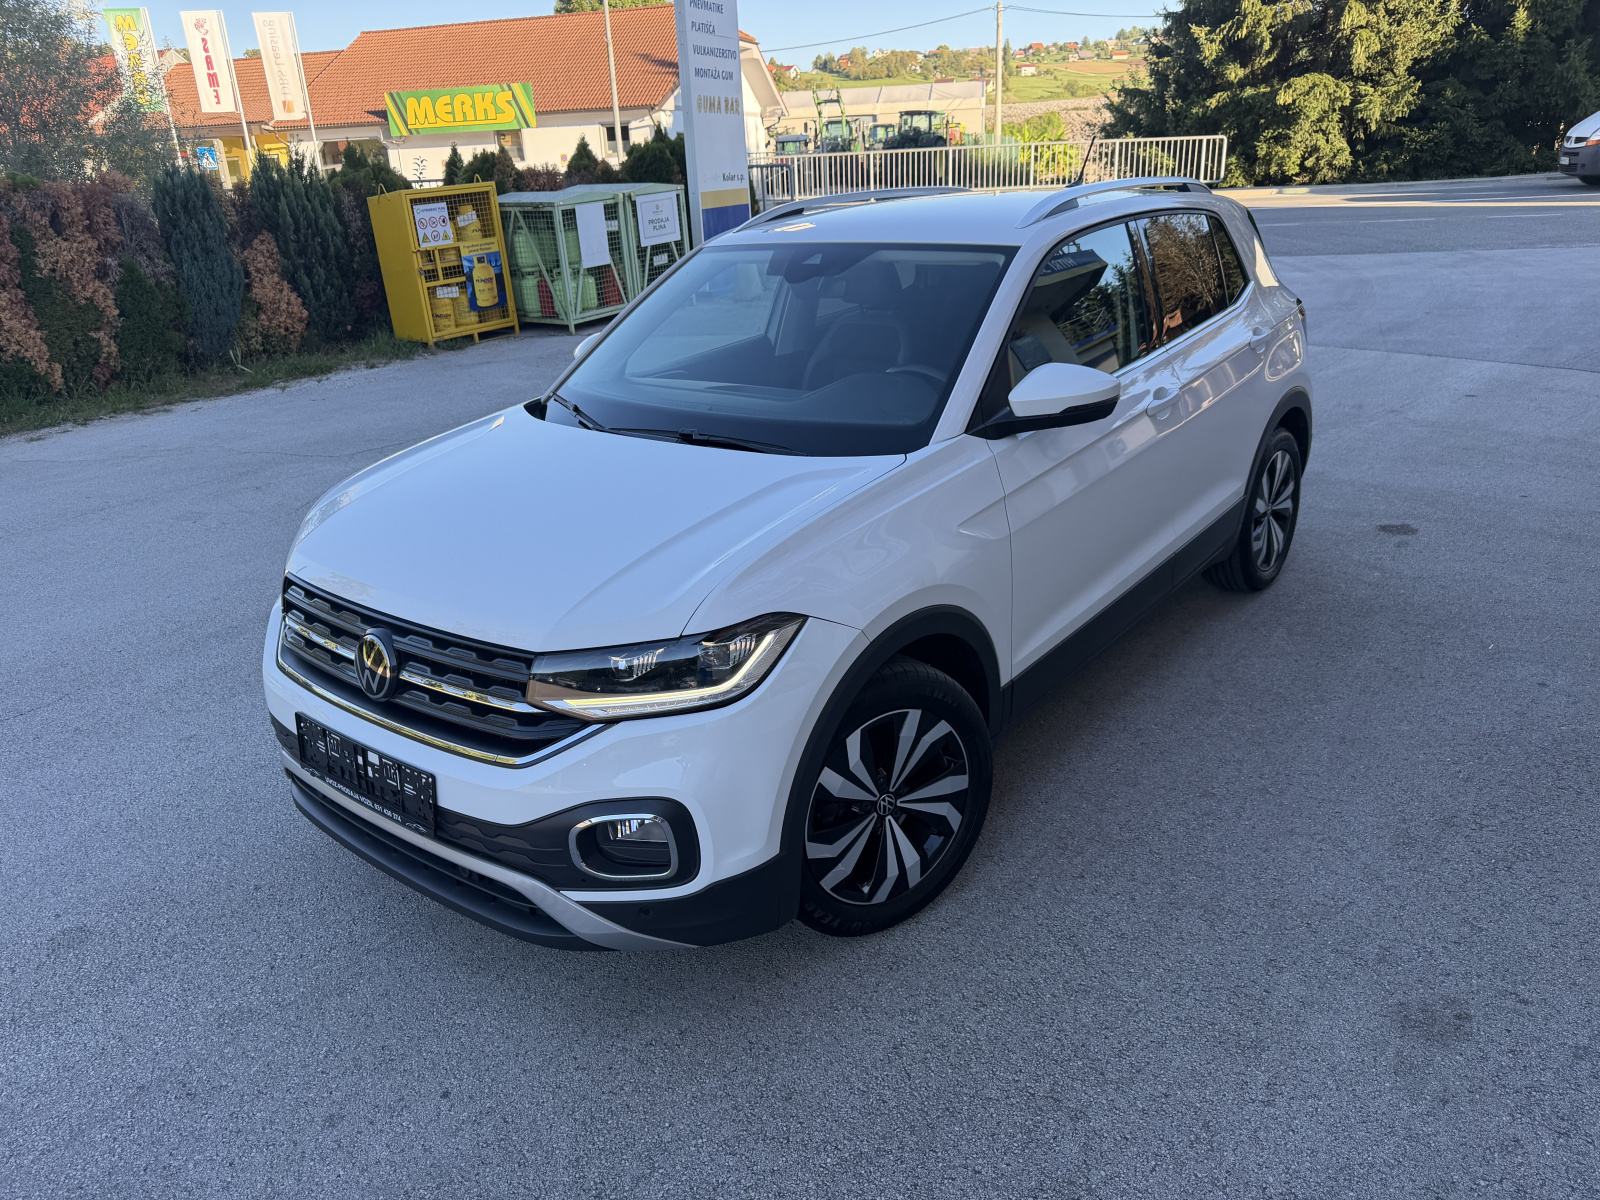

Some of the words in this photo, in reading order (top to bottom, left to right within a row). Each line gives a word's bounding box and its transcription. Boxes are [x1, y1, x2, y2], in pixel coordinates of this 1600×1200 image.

[690, 0, 723, 14] PNEVMATIKE
[693, 44, 736, 60] VULKANIZERSTVO
[695, 66, 720, 80] MONTAŽA
[406, 91, 515, 128] MERKS
